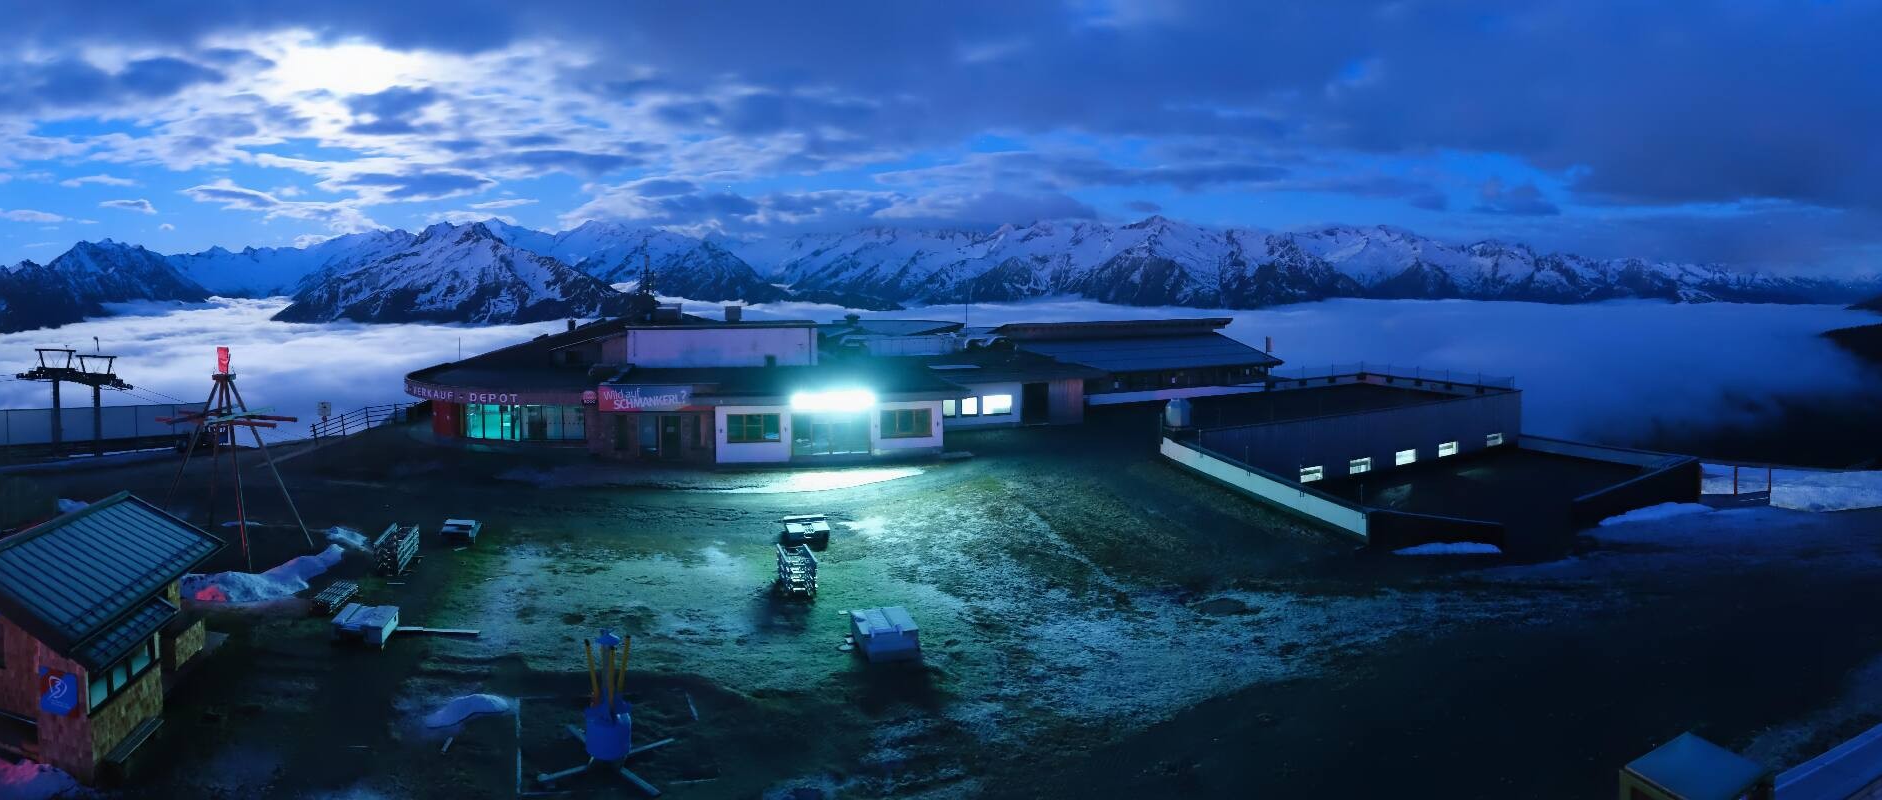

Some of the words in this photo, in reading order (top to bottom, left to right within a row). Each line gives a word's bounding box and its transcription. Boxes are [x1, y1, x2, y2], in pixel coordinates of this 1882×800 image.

[470, 393, 517, 403] DEPOT
[603, 390, 624, 401] Wild
[625, 387, 641, 398] auf
[614, 391, 687, 410] SCHMANKERL?
